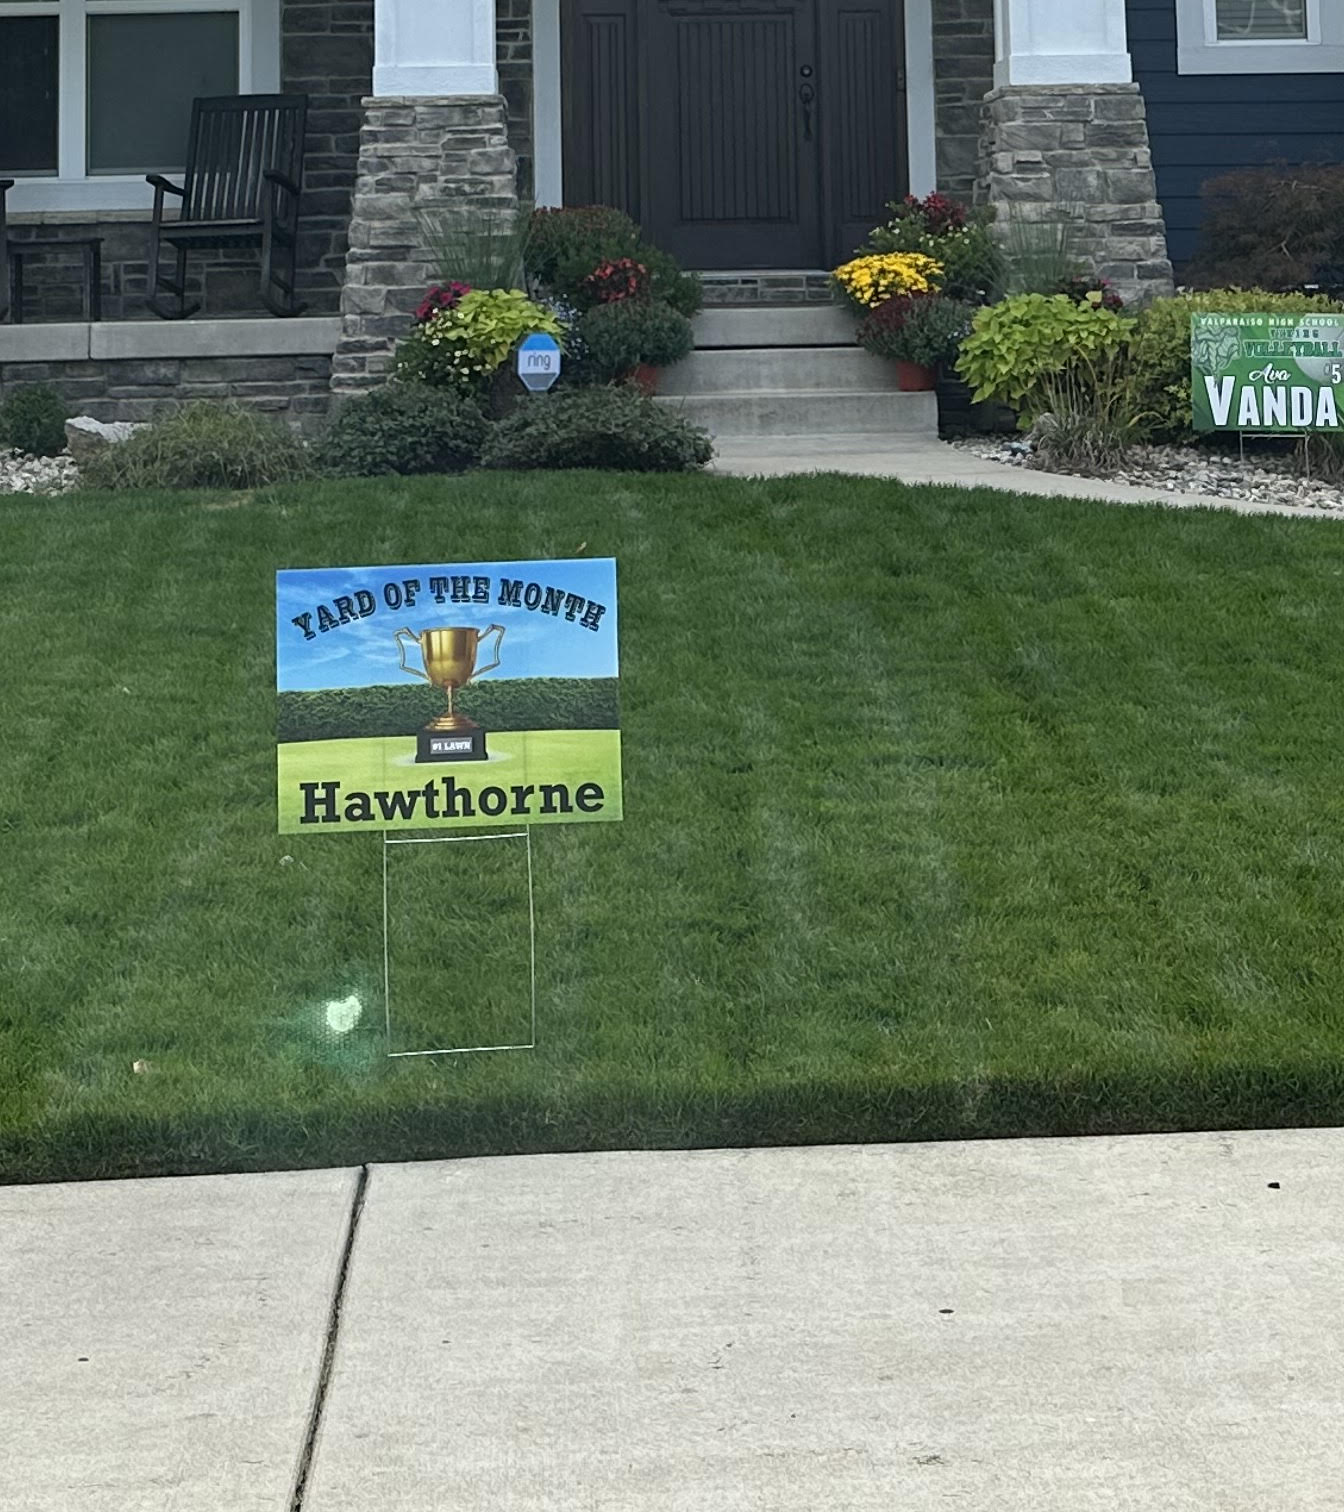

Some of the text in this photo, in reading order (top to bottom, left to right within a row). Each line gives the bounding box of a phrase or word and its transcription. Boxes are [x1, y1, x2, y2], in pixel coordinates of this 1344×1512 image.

[1201, 317, 1339, 326] VALPARAISO HIGH SCHOOL
[1242, 340, 1343, 357] VOLLEYBALL
[527, 352, 551, 370] ring
[1248, 363, 1292, 383] Ava
[1204, 375, 1339, 427] VANDA
[291, 575, 607, 641] YARD OF THE MONTH
[444, 741, 471, 751] LAWN
[299, 777, 605, 825] Hawthorne
